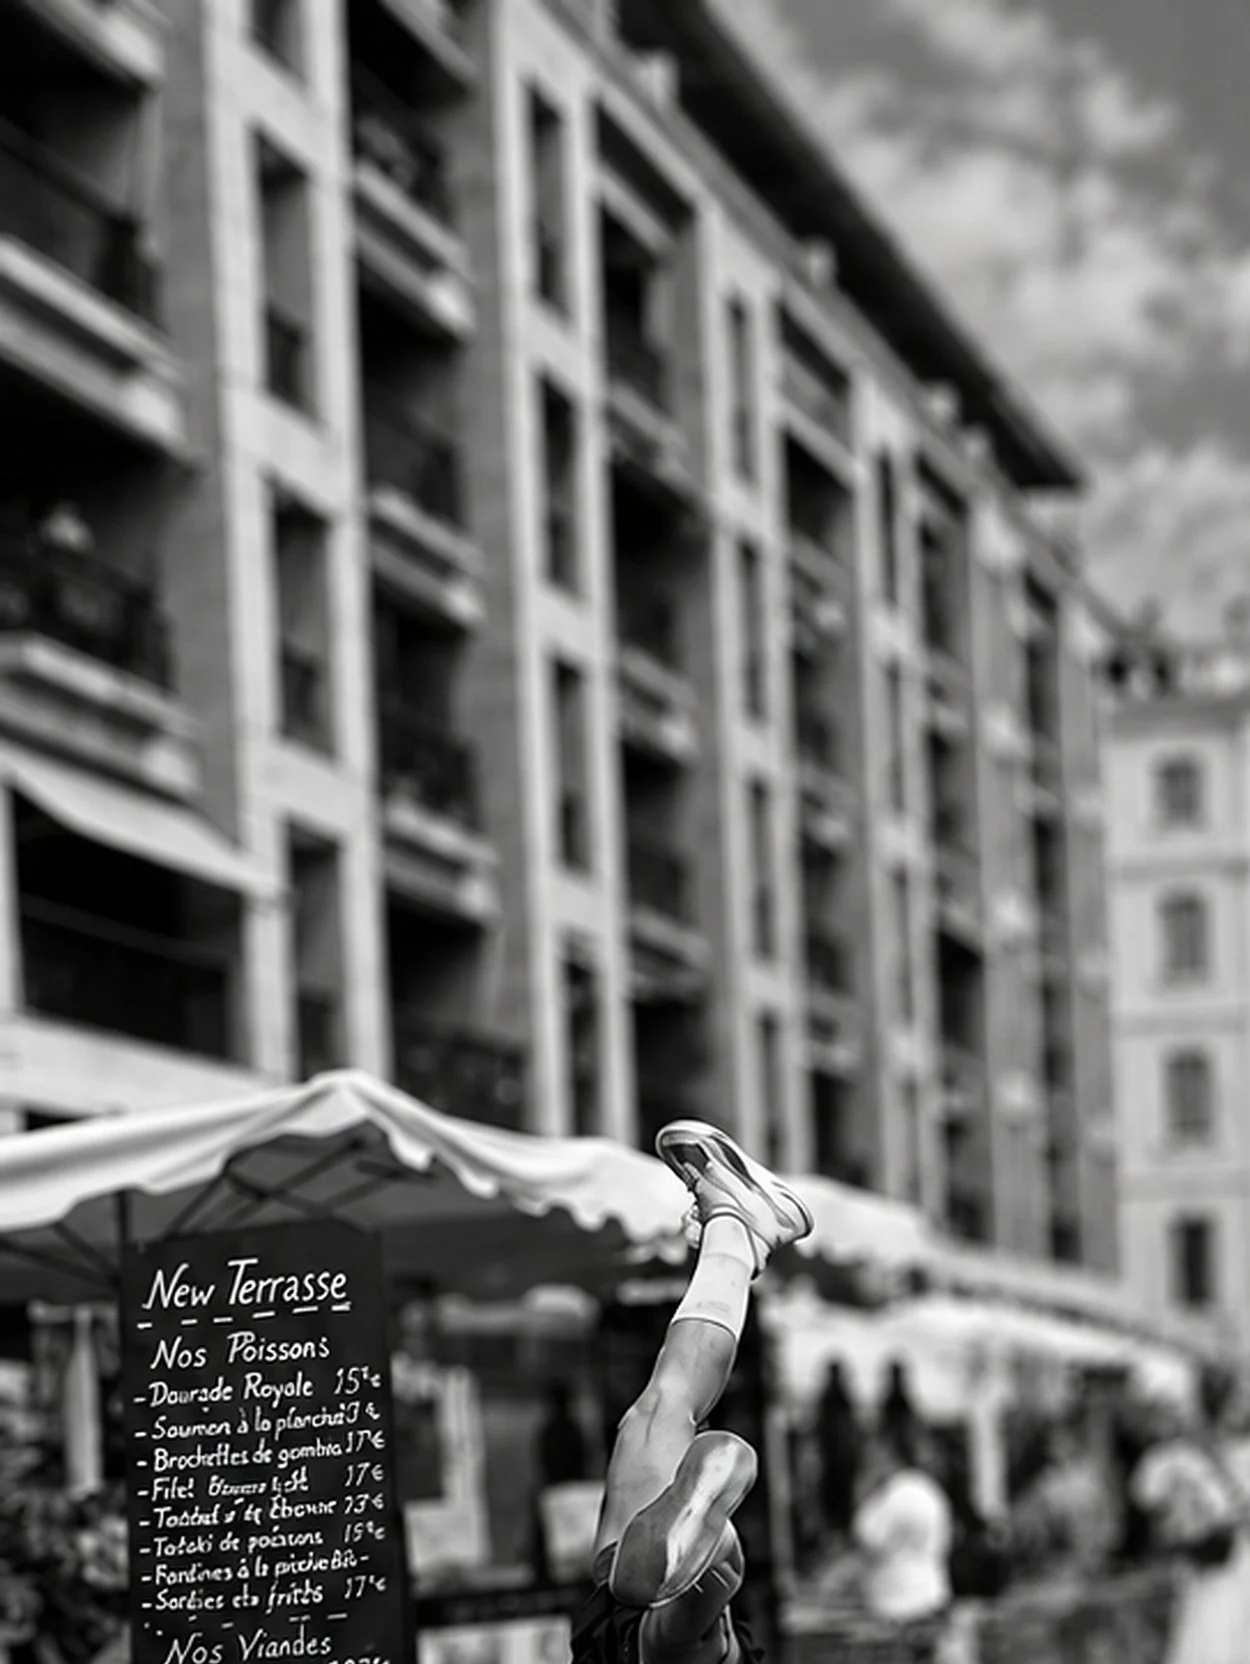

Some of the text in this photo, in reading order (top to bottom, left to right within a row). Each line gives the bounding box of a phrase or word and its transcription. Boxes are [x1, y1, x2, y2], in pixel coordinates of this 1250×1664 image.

[142, 1257, 348, 1310] New Terrasse
[150, 1330, 331, 1370] Nos Poissons
[243, 1371, 314, 1409] Royale
[238, 1624, 331, 1661] Viandes
